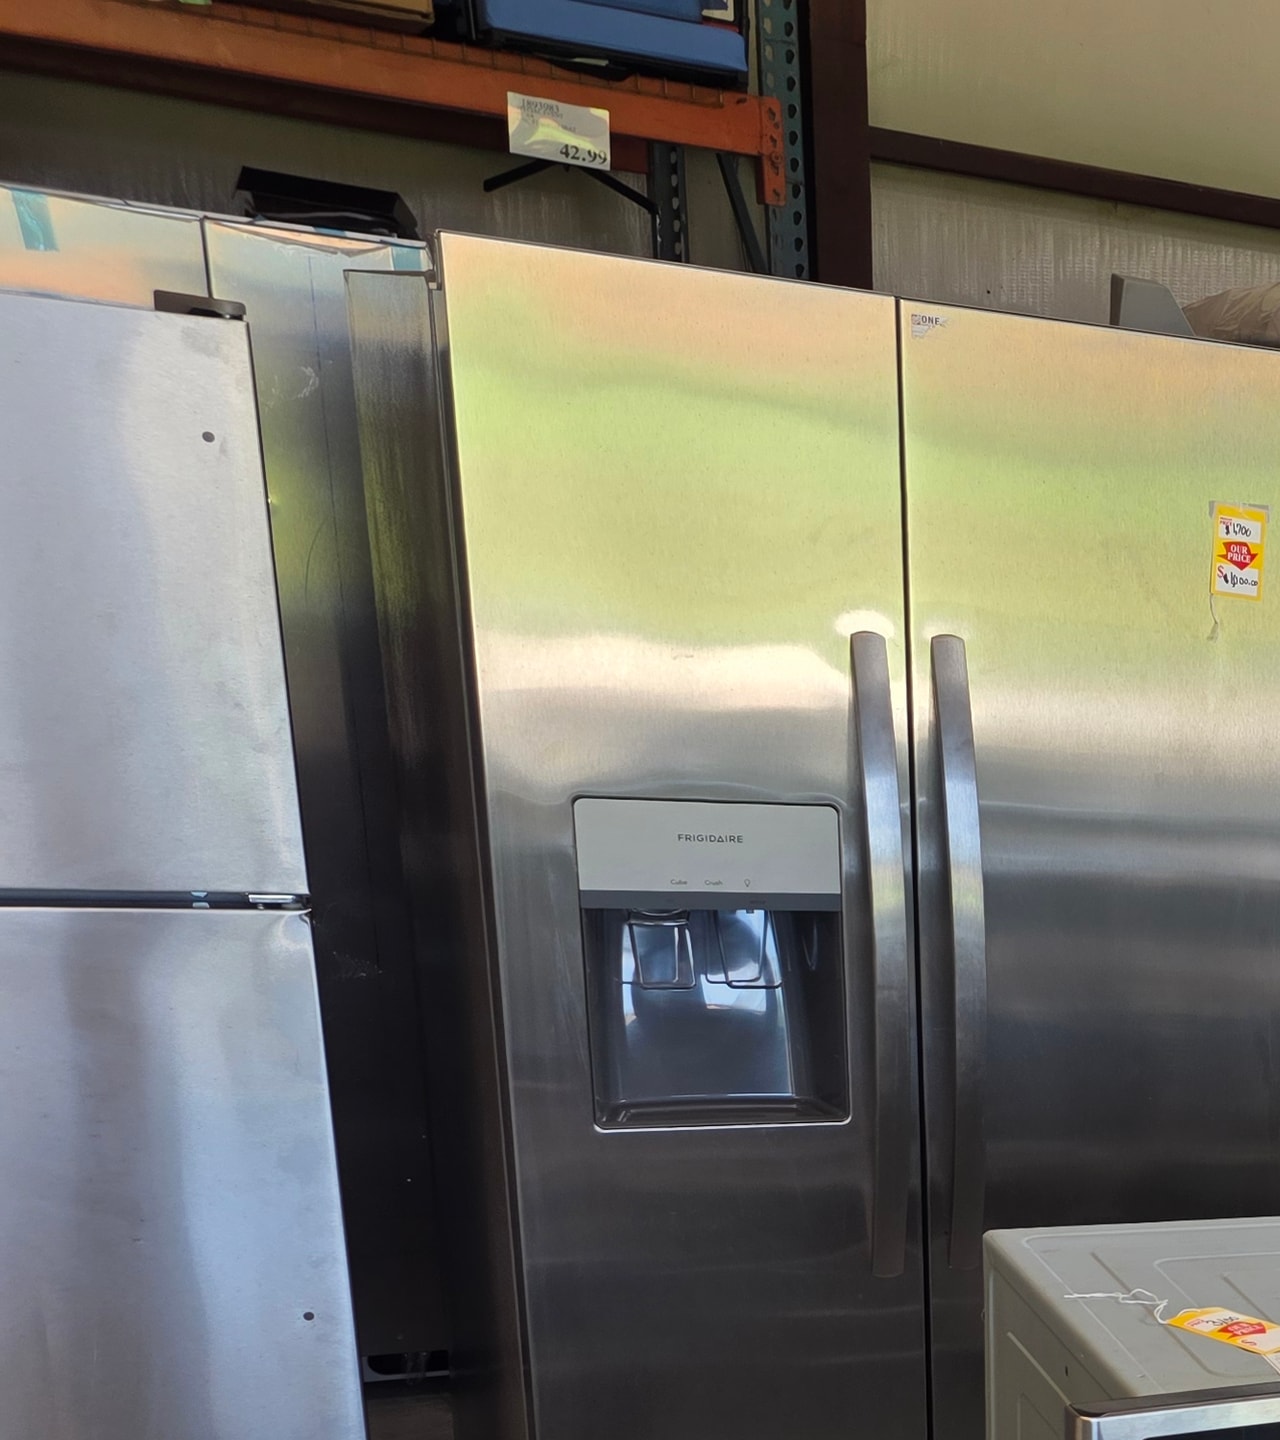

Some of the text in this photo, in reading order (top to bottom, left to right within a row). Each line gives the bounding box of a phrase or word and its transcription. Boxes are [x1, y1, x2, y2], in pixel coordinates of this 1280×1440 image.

[560, 144, 607, 164] 42.99
[1231, 544, 1248, 554] OUR
[1228, 552, 1251, 563] PRICE
[678, 834, 744, 843] FRIGIDAIRE
